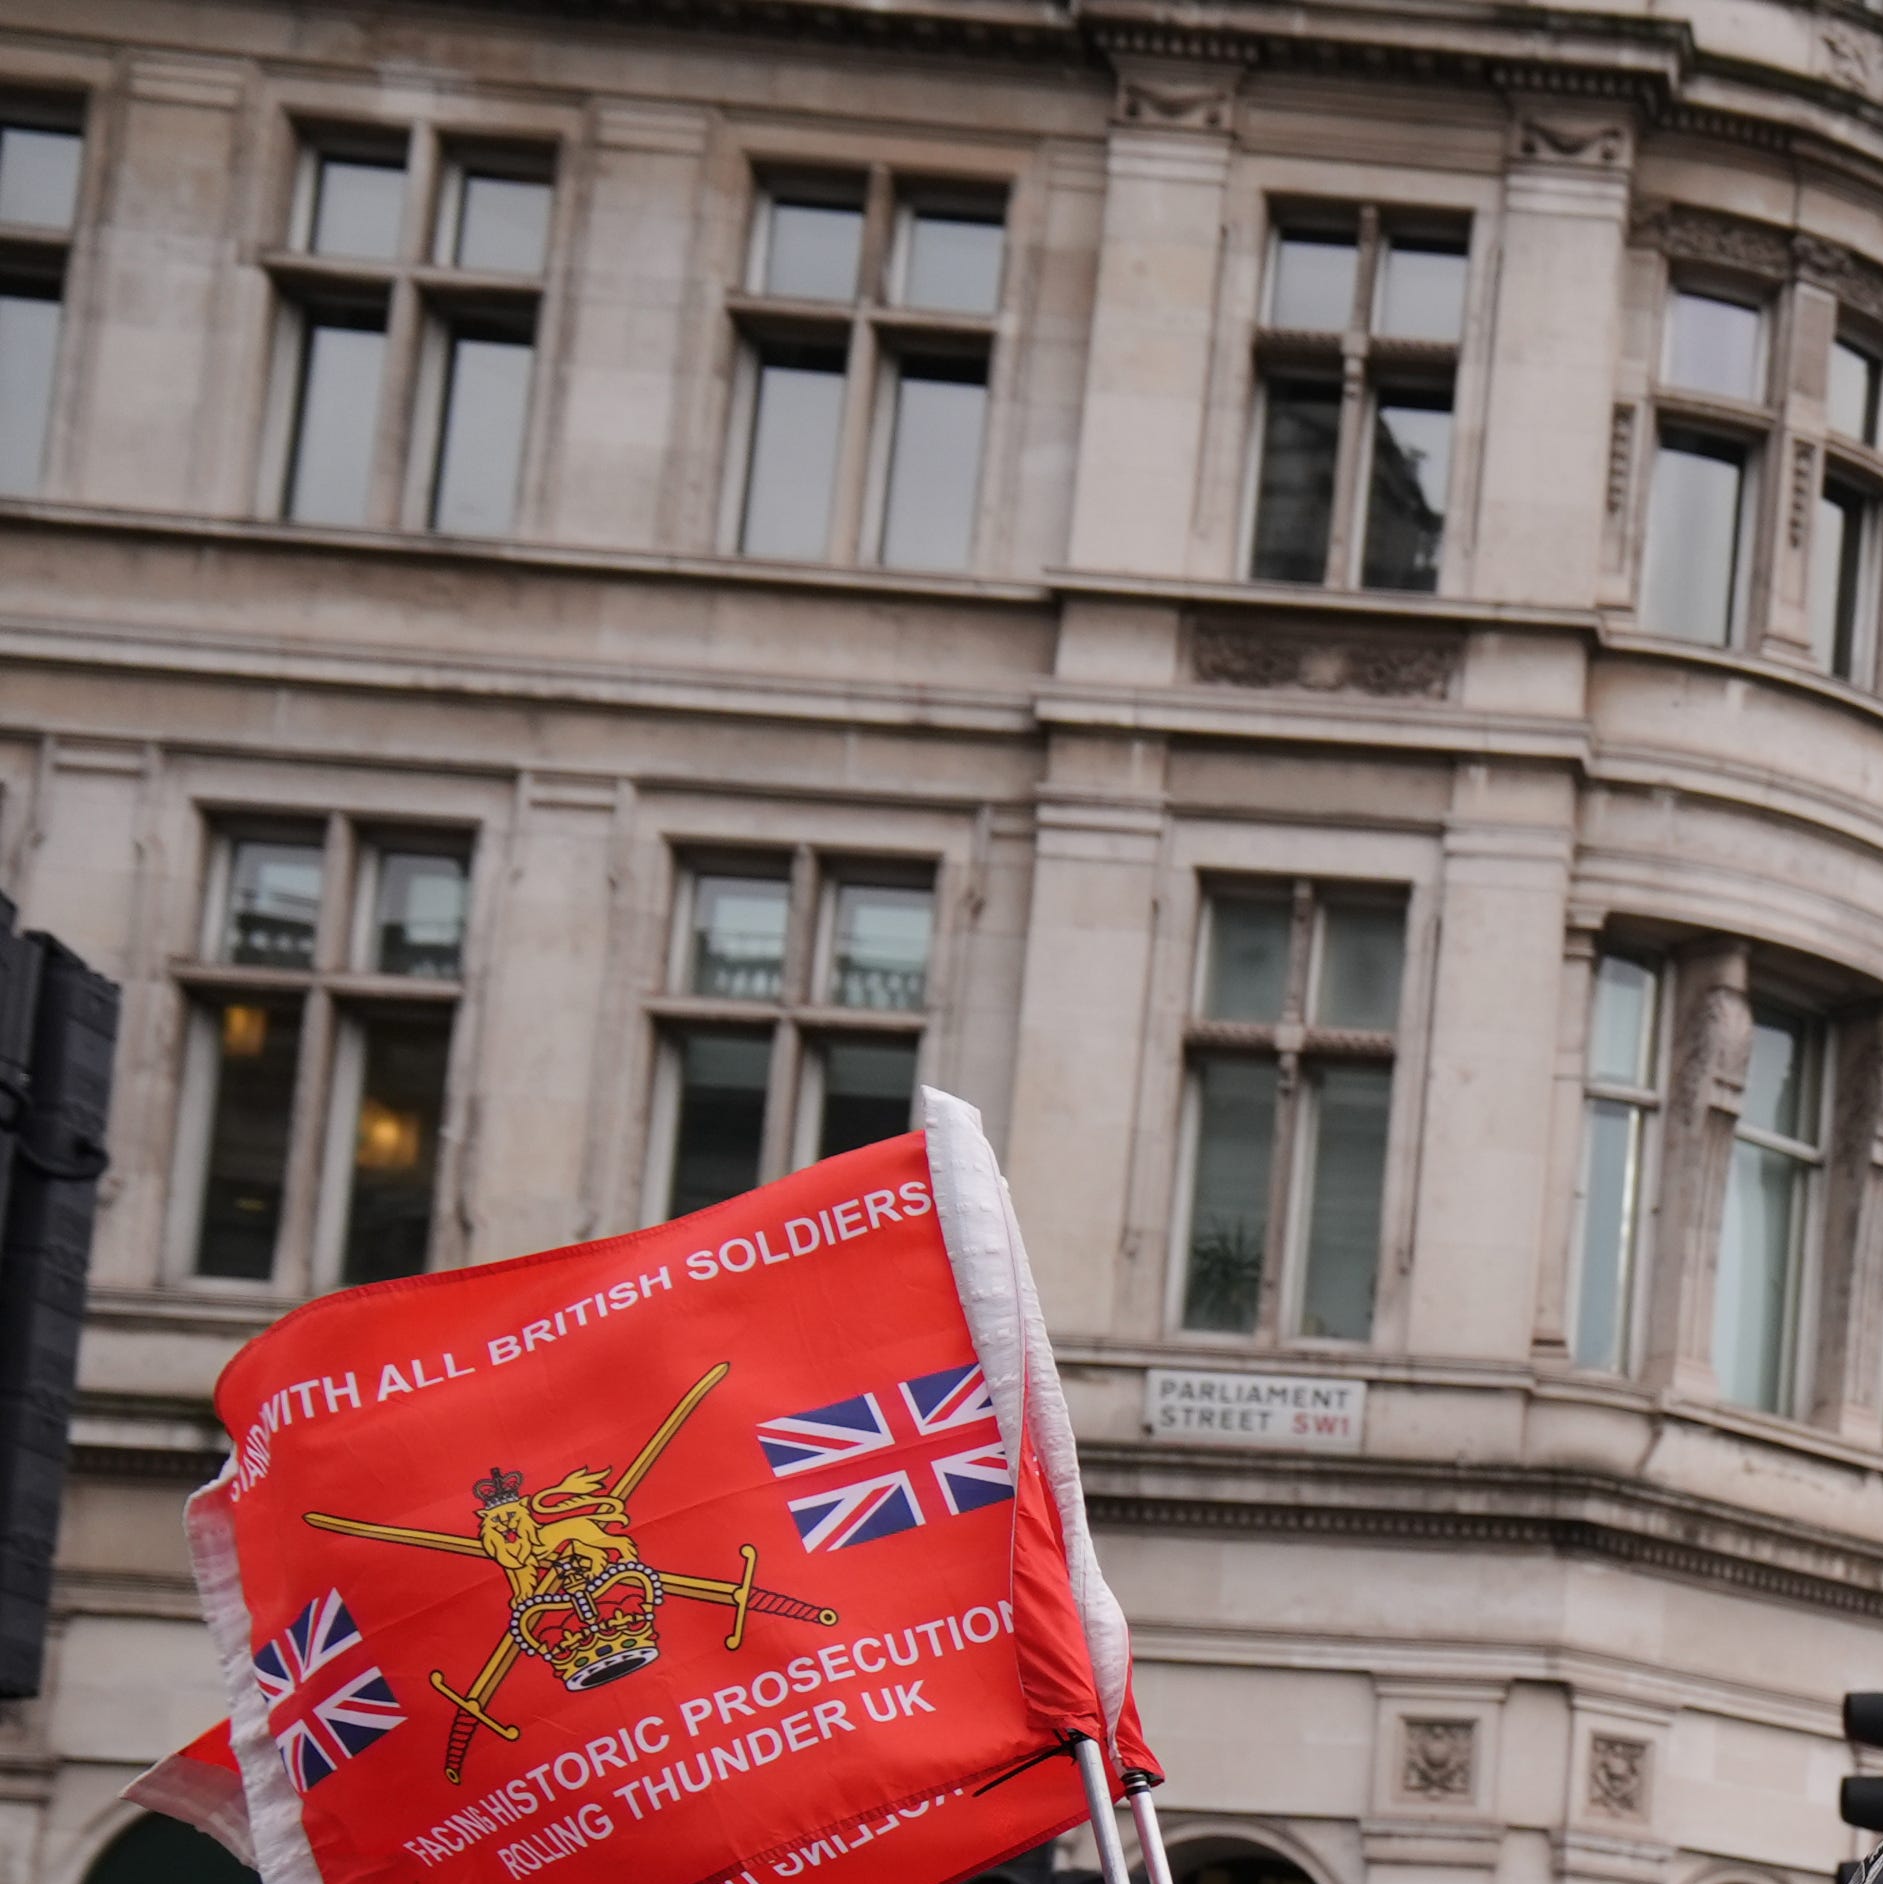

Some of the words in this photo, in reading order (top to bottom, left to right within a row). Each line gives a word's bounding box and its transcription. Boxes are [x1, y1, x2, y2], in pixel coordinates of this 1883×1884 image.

[259, 1371, 362, 1440] WITH
[377, 1353, 476, 1401] ALL
[487, 1266, 673, 1366] BRITISH
[686, 1181, 933, 1281] SOLDIERS
[1159, 1378, 1350, 1410] PARLIAMENT
[1159, 1404, 1273, 1432] STREET
[1293, 1413, 1350, 1437] SW1
[403, 1805, 498, 1867] FACING
[479, 1716, 670, 1826] HISTORIC
[497, 1803, 615, 1880] ROLLING
[614, 1700, 856, 1820] THUNDER
[861, 1680, 936, 1723] UK
